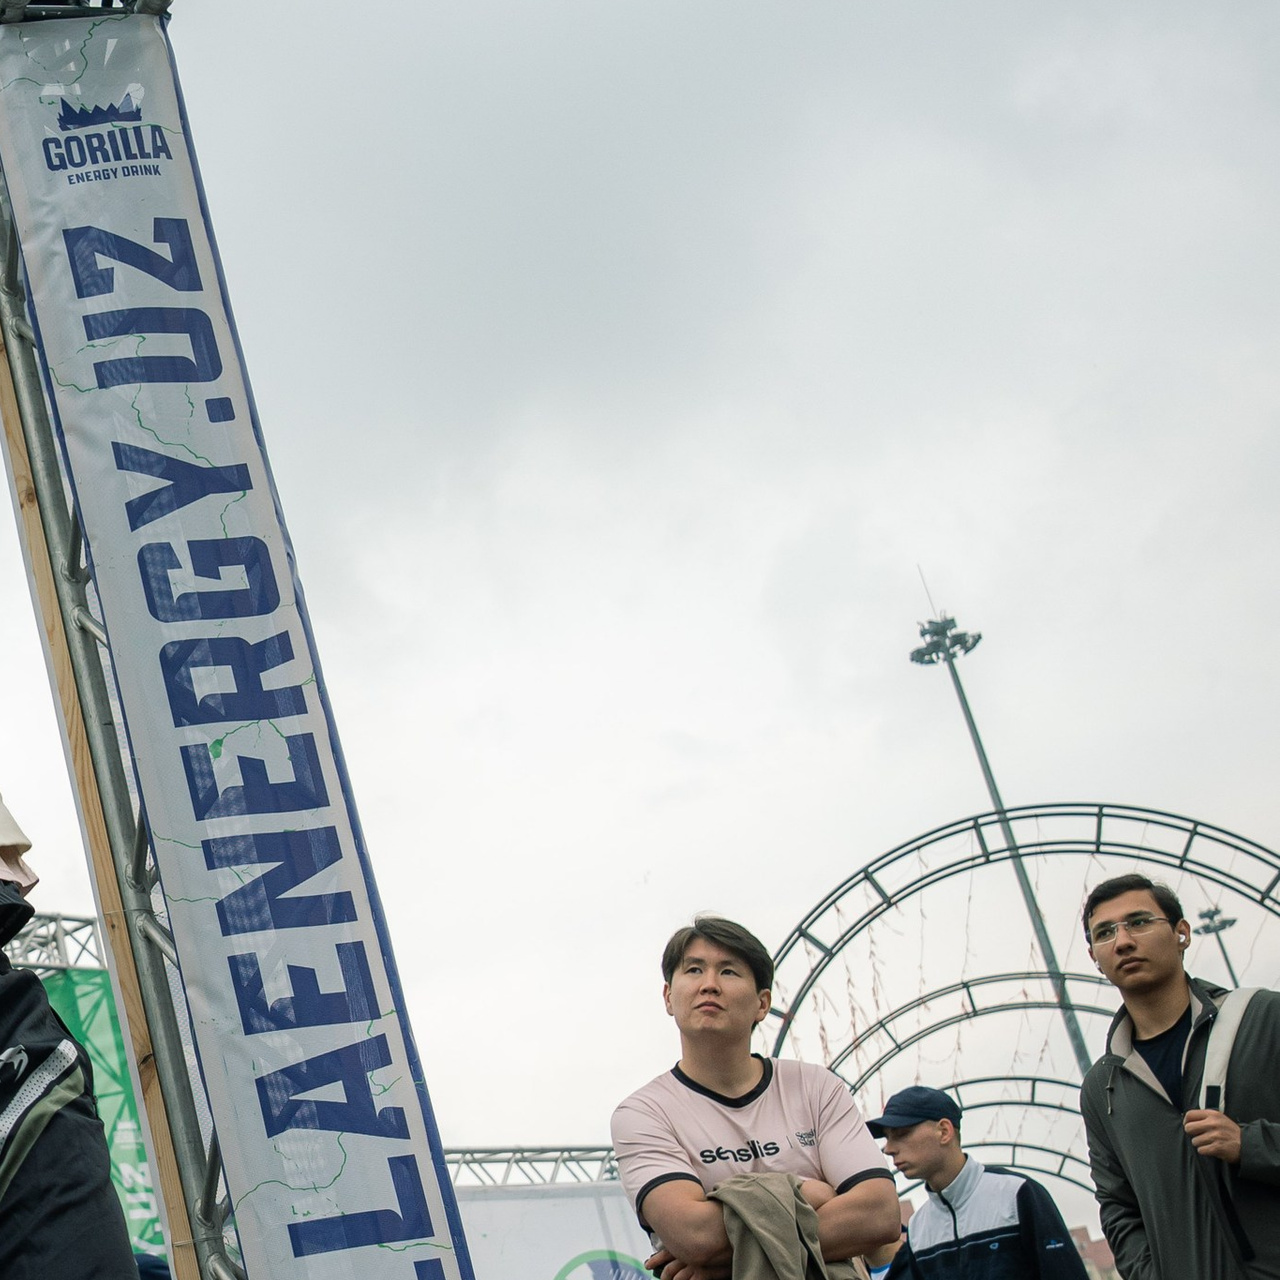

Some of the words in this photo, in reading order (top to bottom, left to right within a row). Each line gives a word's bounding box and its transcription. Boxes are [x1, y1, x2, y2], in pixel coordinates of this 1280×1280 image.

[42, 125, 173, 171] GORILLA
[67, 167, 119, 185] ENERGY
[122, 164, 161, 177] DRINK
